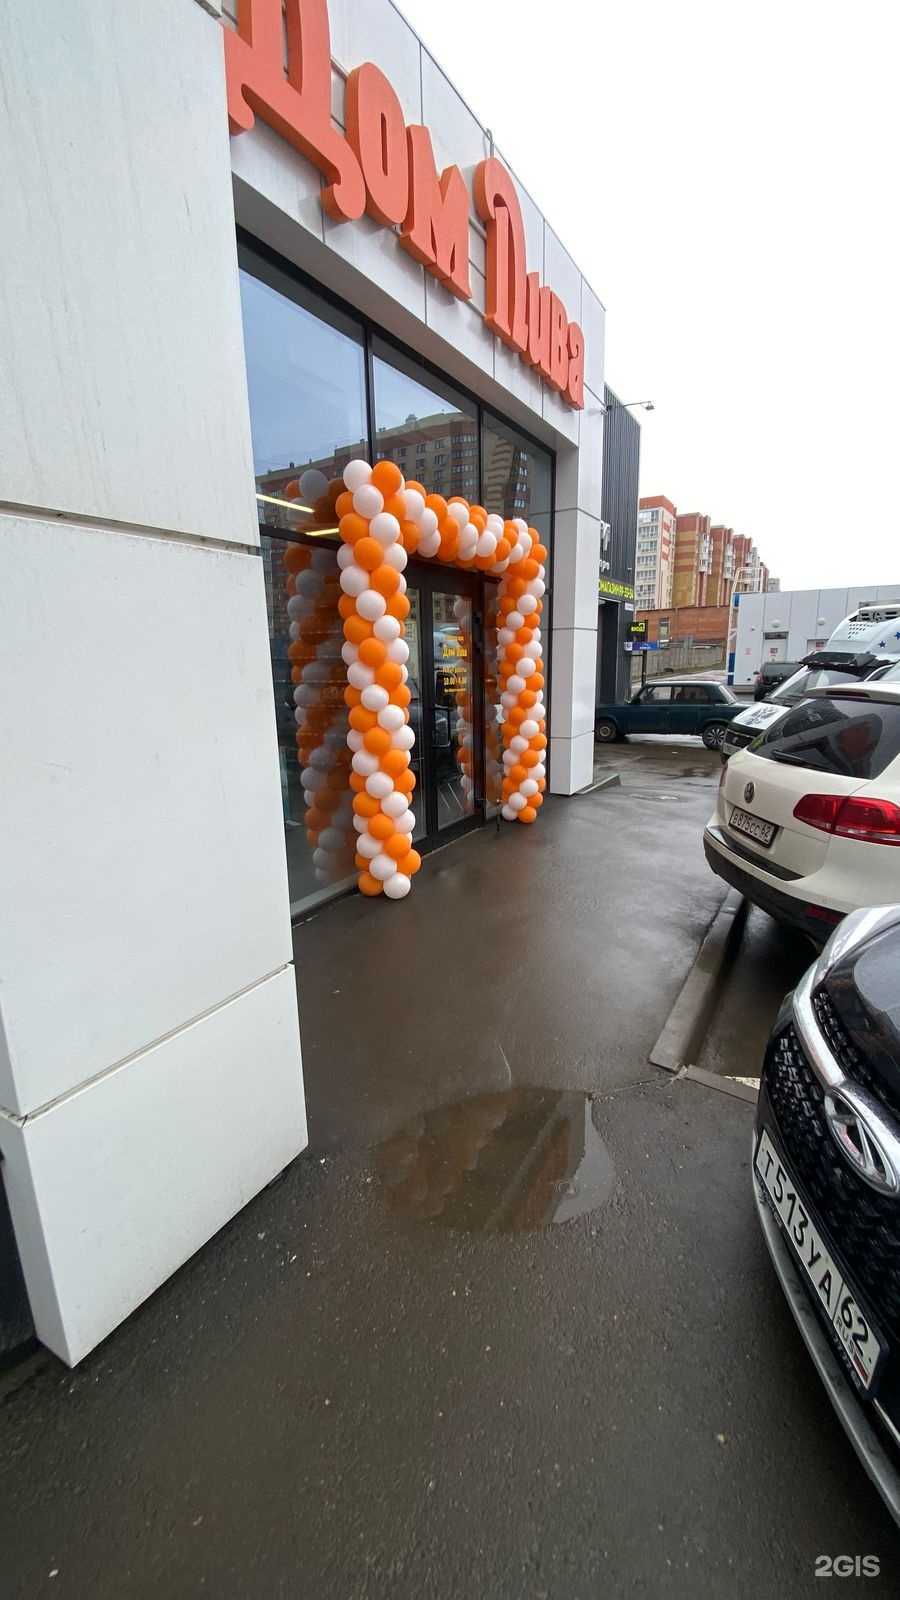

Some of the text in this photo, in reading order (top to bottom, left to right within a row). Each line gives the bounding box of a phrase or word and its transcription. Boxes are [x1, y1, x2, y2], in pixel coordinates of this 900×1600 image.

[223, 0, 585, 411] Дом Пива
[761, 1149, 833, 1307] Т513УА
[841, 1296, 869, 1356] 62
